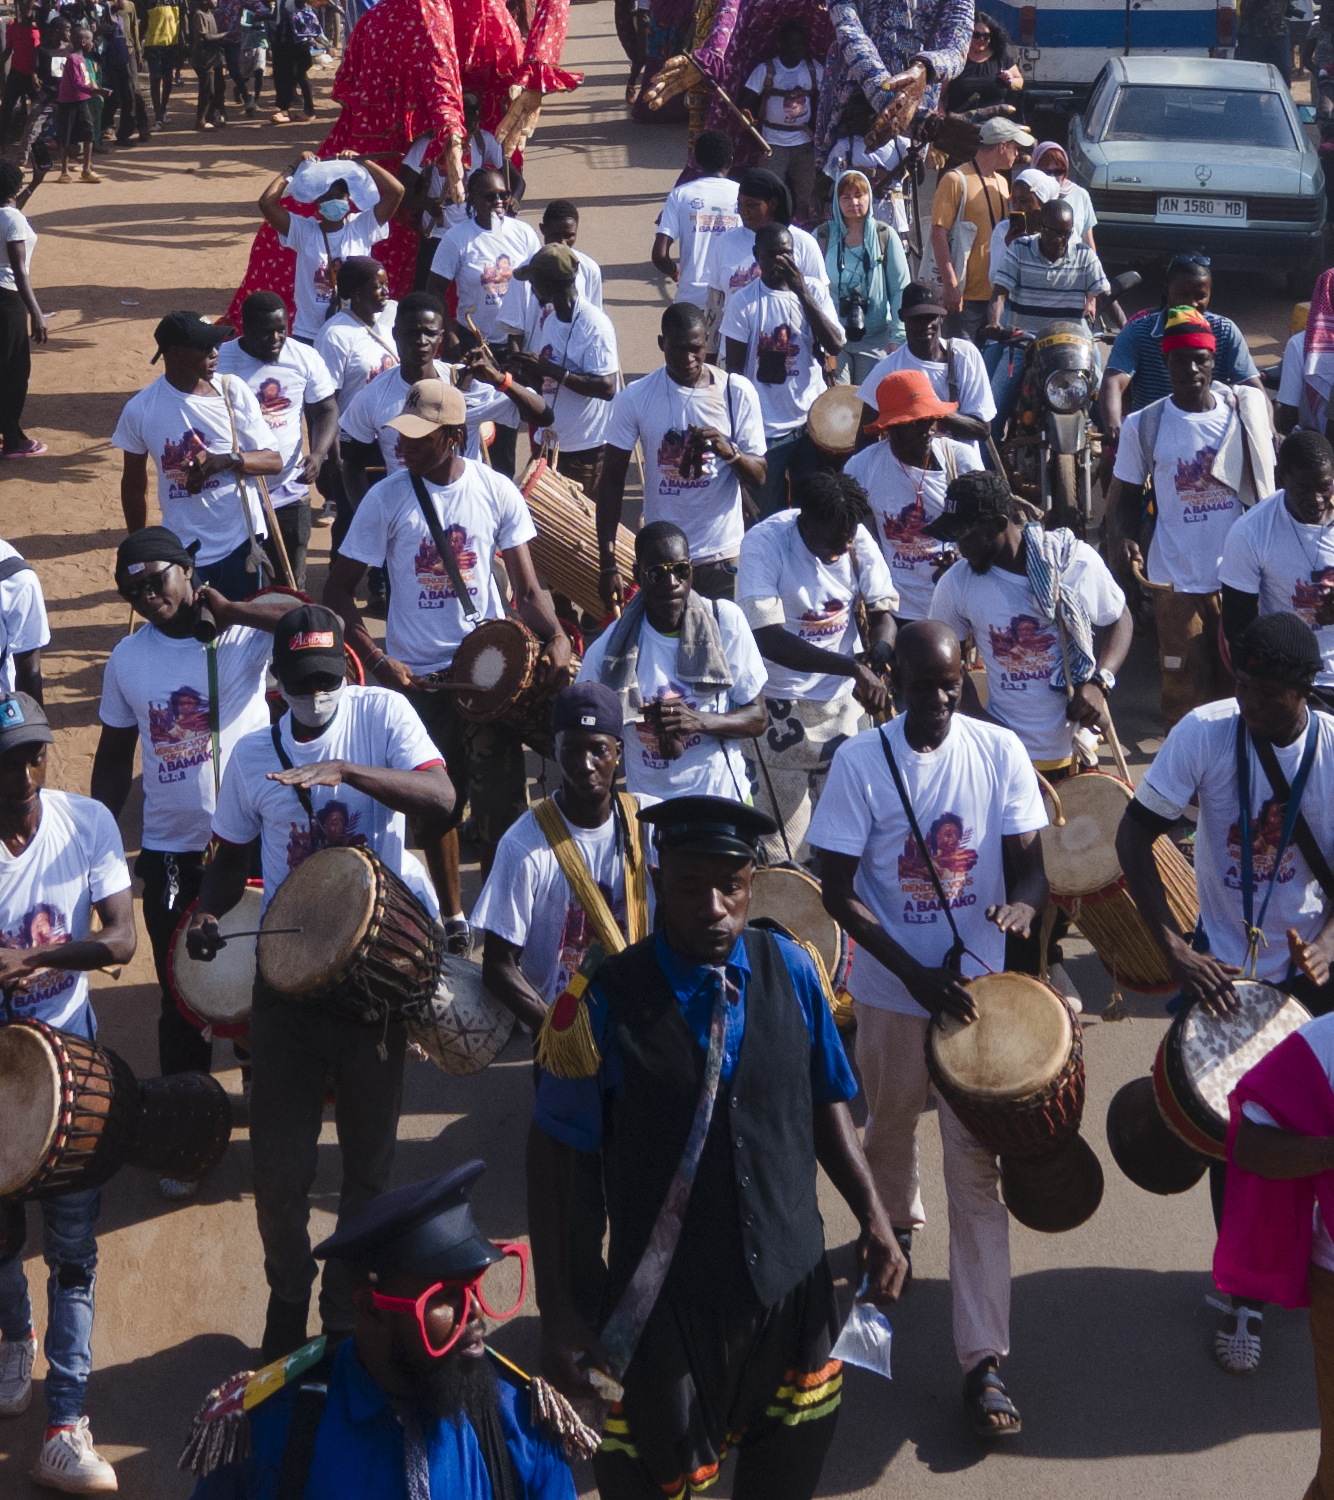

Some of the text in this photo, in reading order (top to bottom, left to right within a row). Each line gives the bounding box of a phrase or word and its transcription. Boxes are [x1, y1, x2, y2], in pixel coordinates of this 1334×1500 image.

[1162, 198, 1242, 216] AN 1580 MD
[1193, 501, 1234, 514] BAMAKO
[429, 587, 478, 600] BAMO
[1010, 669, 1054, 681] BAMAK
[158, 763, 166, 774] A
[902, 877, 974, 893] REND-VOUS
[903, 900, 914, 912] A
[14, 974, 75, 1008] BAMAKO
